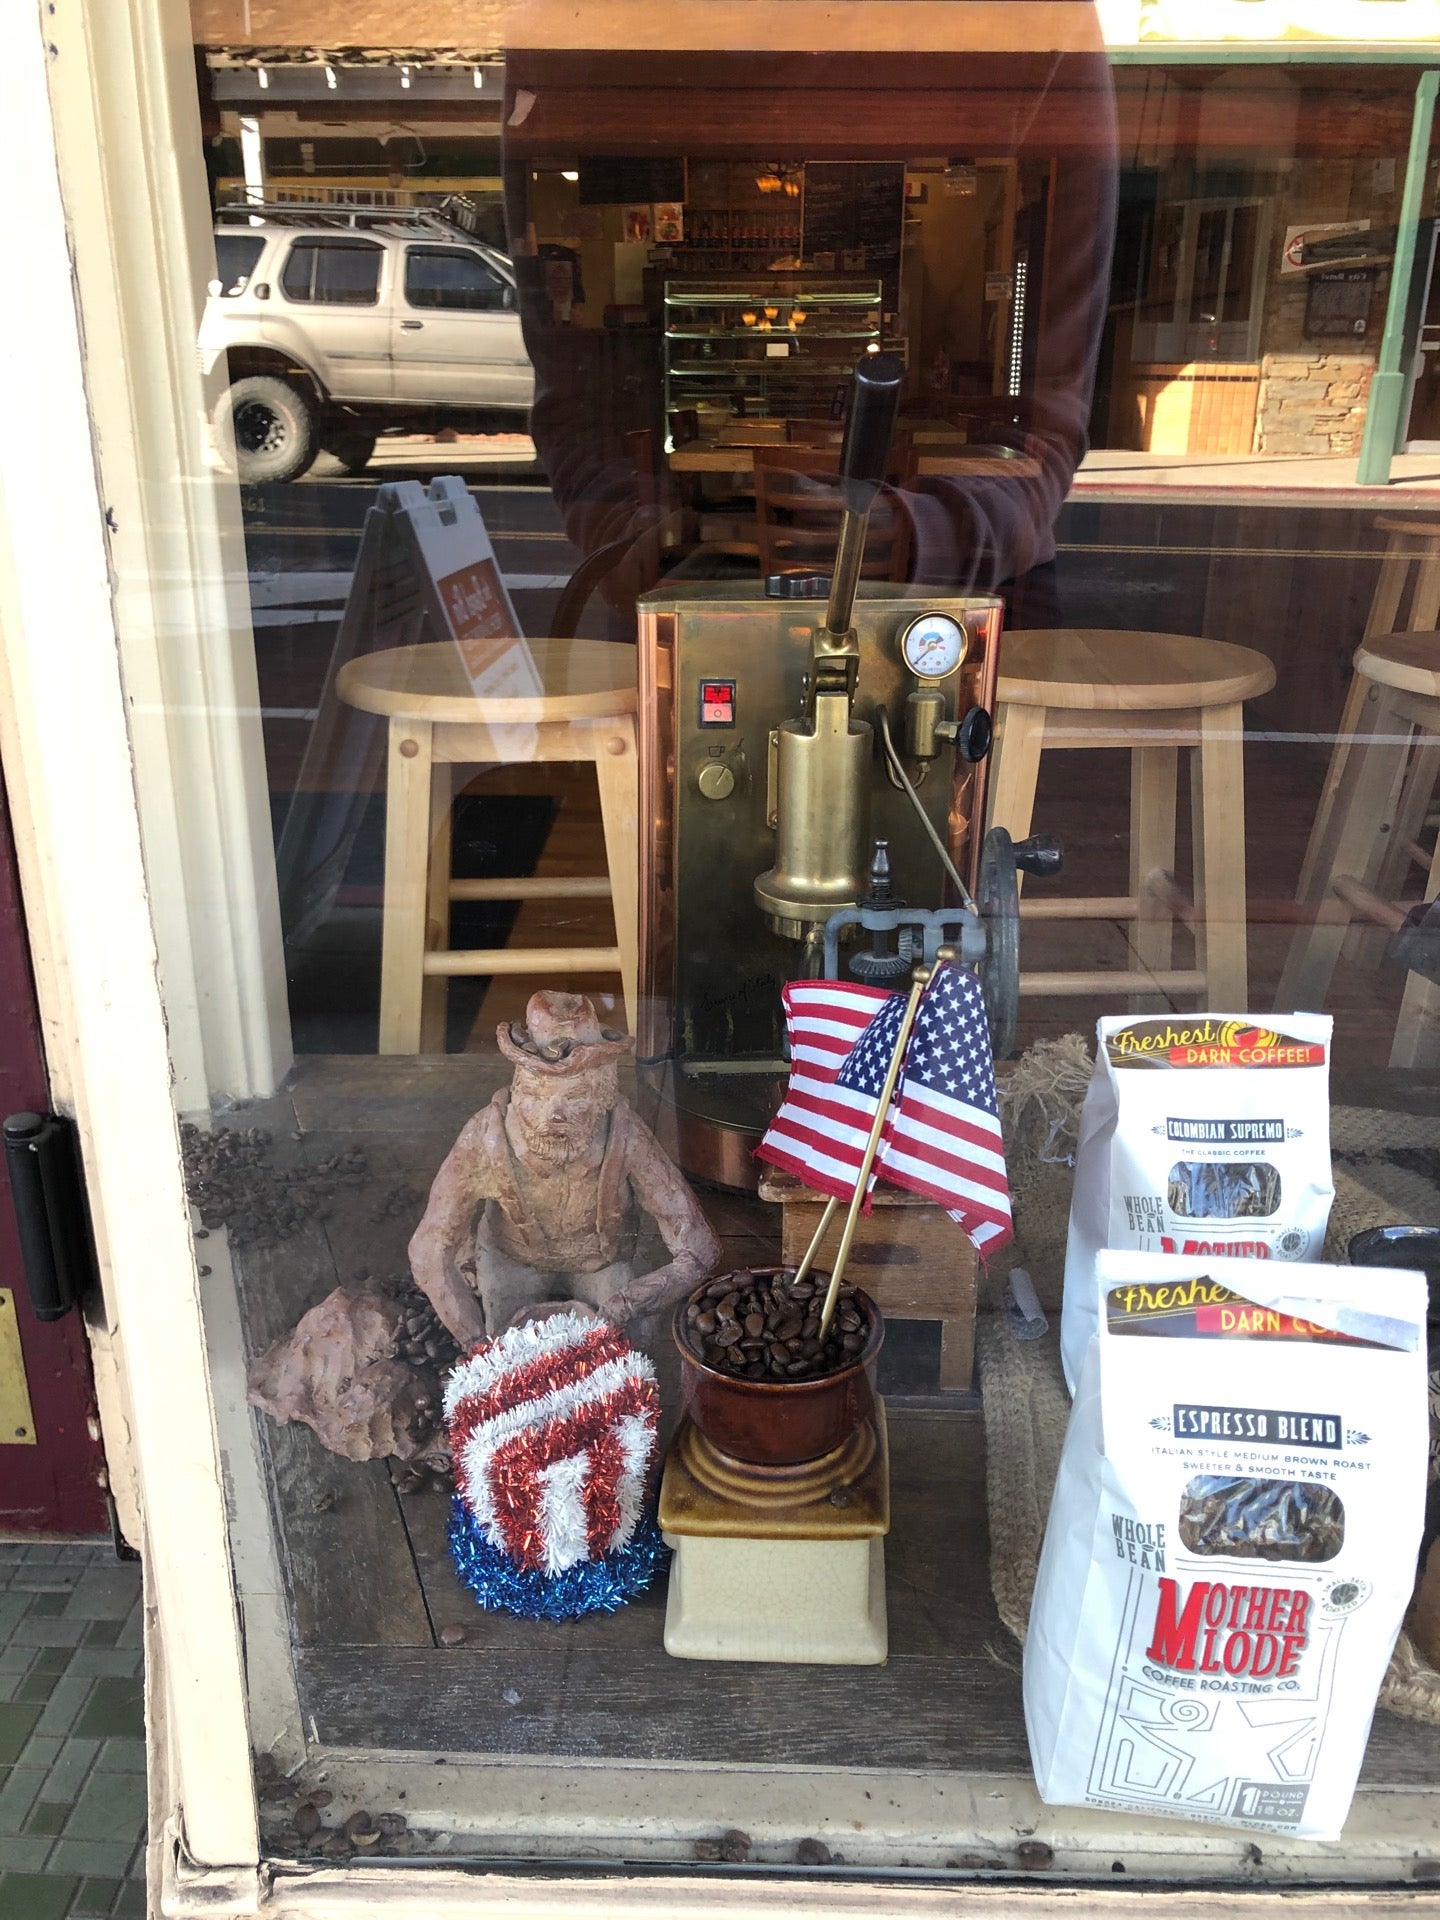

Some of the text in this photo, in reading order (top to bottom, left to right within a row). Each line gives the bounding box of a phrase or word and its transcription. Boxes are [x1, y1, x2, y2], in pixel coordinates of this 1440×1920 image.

[1113, 1020, 1216, 1055] Freshest
[1187, 1048, 1310, 1063] DARN COFFEE!
[1168, 1120, 1283, 1139] COLOMBIAN SUPREMO
[1123, 1195, 1164, 1215] WHOLE
[1128, 1213, 1165, 1233] BEAN
[1115, 1279, 1243, 1313] Freshe
[1221, 1309, 1280, 1332] DARN
[1178, 1410, 1337, 1443] ESPRESSO BLEND
[1151, 1446, 1193, 1456] ITALIAN
[1234, 1451, 1279, 1461] MEDIUM
[1284, 1455, 1328, 1466] BROWN
[1333, 1459, 1371, 1471] ROAST
[1183, 1461, 1337, 1480] SWEETER & SMOOTH TASTE
[1111, 1513, 1165, 1548] WHOLE
[1115, 1537, 1166, 1573] BEAN
[1146, 1577, 1311, 1671] MOTHER
[1199, 1629, 1306, 1677] LODE
[1142, 1665, 1301, 1694] COFFEE ROASTING CO.
[1241, 1786, 1304, 1816] 1 POUND
[1277, 1808, 1299, 1817] OZ.
